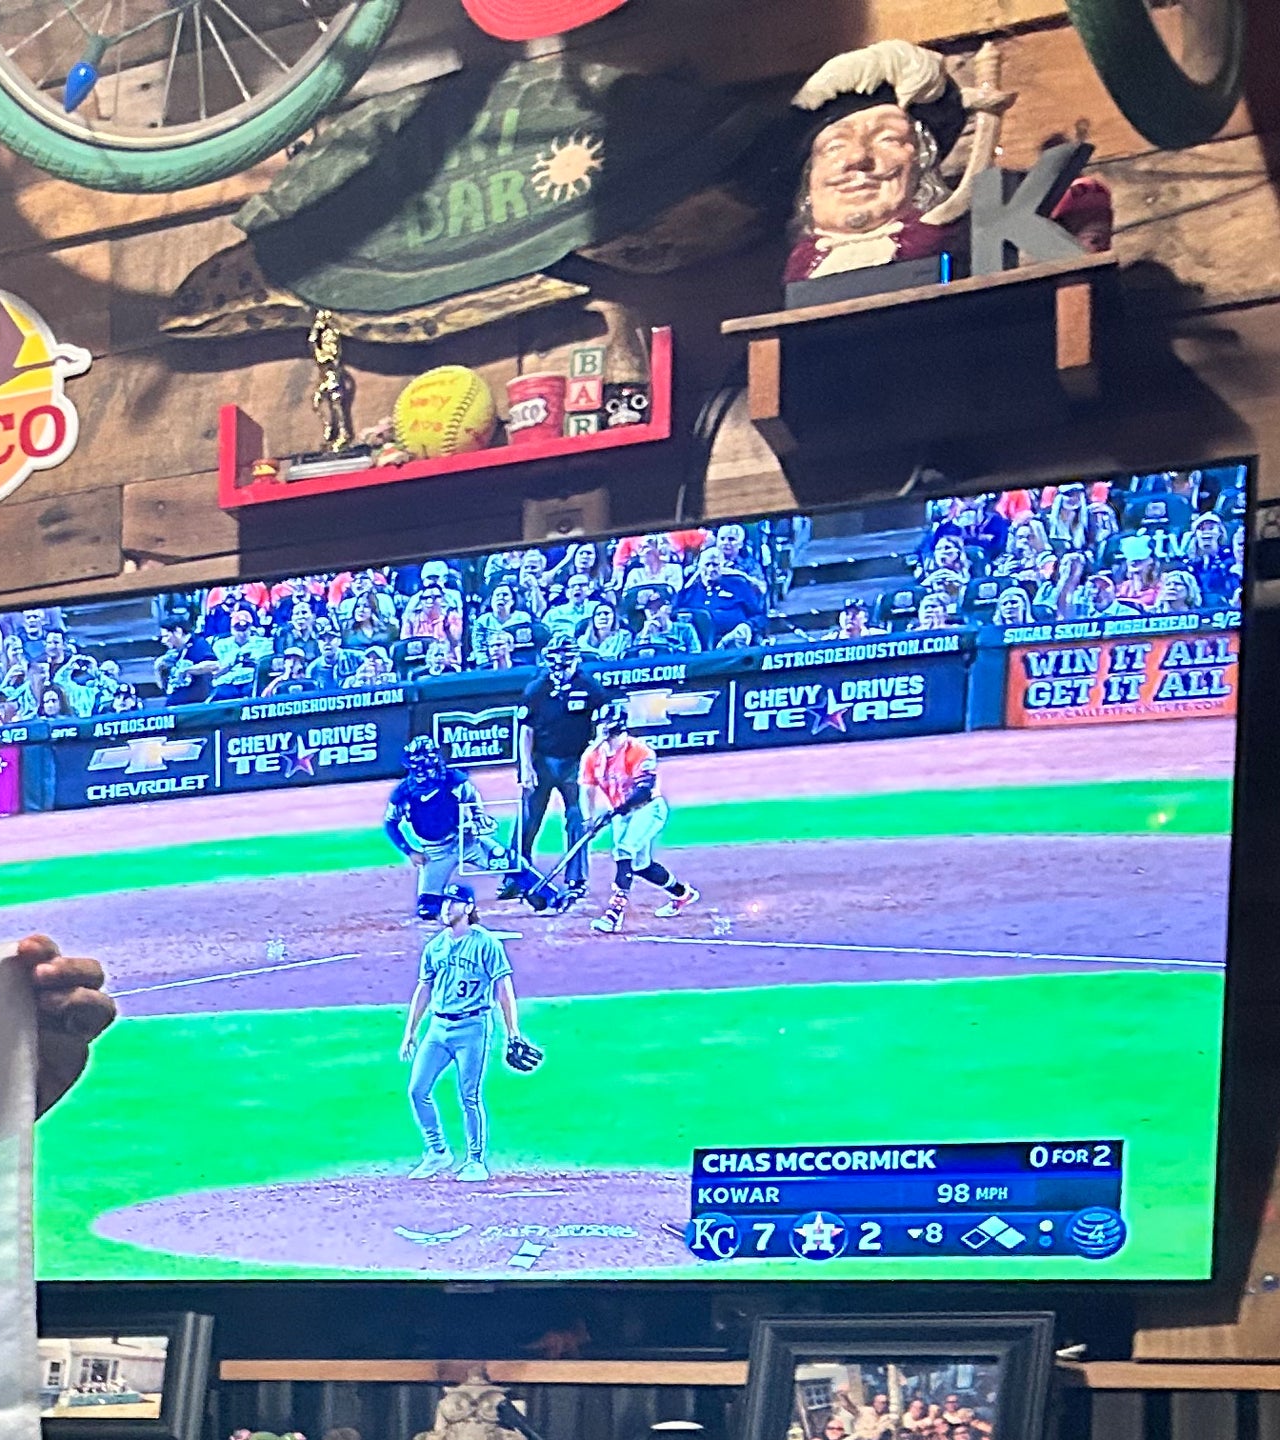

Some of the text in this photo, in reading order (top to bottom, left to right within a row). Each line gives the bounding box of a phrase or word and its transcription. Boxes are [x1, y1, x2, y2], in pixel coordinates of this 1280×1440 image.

[1153, 529, 1194, 558] tv
[1004, 626, 1052, 643] SUGAR
[1054, 622, 1102, 640] SKULL
[761, 635, 959, 670] ASTROSDEHOUSTON.COM
[1026, 637, 1239, 679] WIN IT ALL
[744, 674, 924, 710] CHEVY DRIVES
[1026, 668, 1232, 708] GET IT ALL
[241, 688, 404, 721] ASTROSDEHOUSTON.COM
[1, 727, 28, 744] 9/23
[93, 714, 176, 737] ASTROS.COM
[443, 723, 509, 744] Minute
[227, 722, 378, 755] CHEVY DRIVES
[638, 730, 720, 750] ROLET
[86, 775, 210, 801] CHEVROLET
[456, 980, 481, 998] 37
[701, 1149, 937, 1173] CHAS MCCORMICK
[1029, 1145, 1112, 1168] 0 FOR 2
[697, 1186, 780, 1204] KOWAR
[937, 1183, 1009, 1203] 98 MPH
[691, 1218, 735, 1258] KC
[752, 1222, 776, 1251] 7
[858, 1221, 882, 1250] 2
[925, 1222, 943, 1243] 8
